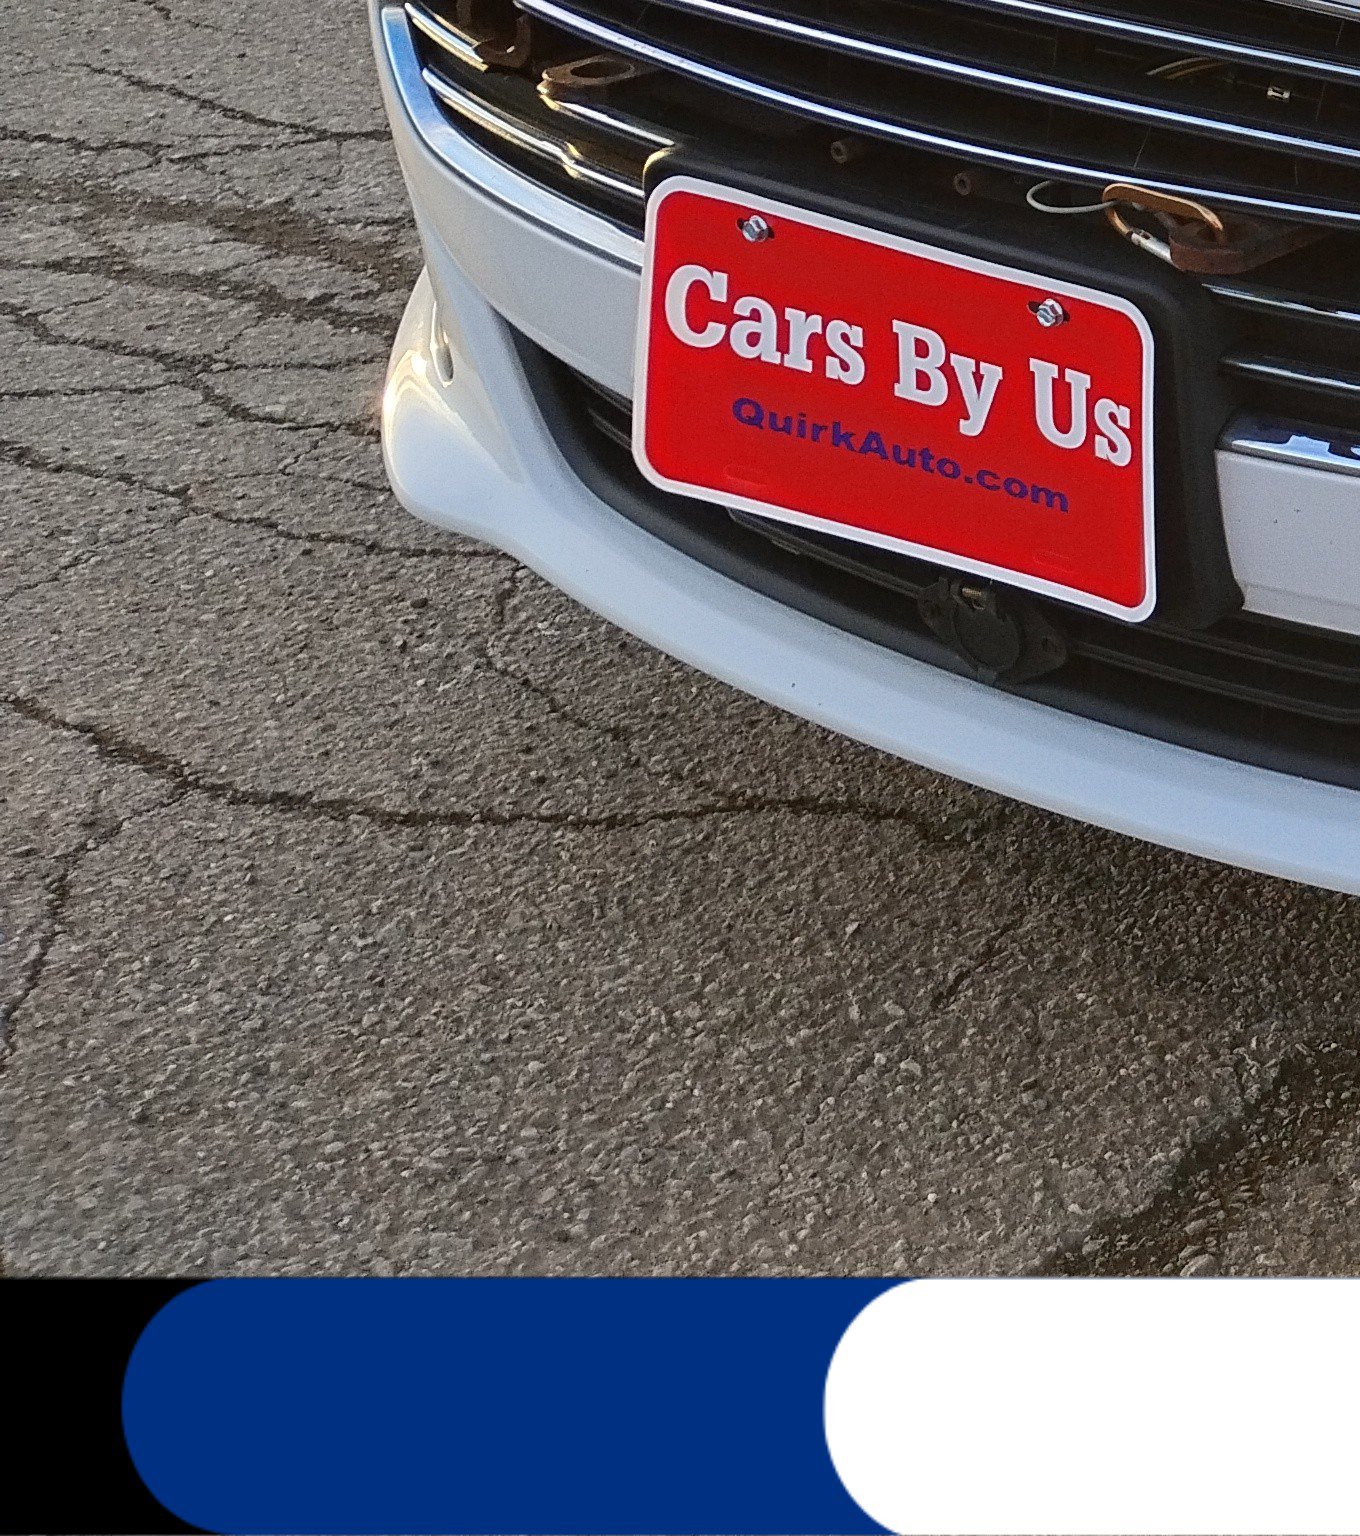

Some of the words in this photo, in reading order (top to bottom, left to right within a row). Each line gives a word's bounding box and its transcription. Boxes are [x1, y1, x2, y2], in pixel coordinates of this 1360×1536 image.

[664, 264, 866, 386] Cars
[891, 318, 1004, 437] By
[1029, 357, 1133, 468] Us
[731, 396, 1070, 514] QuirkAuto.com
